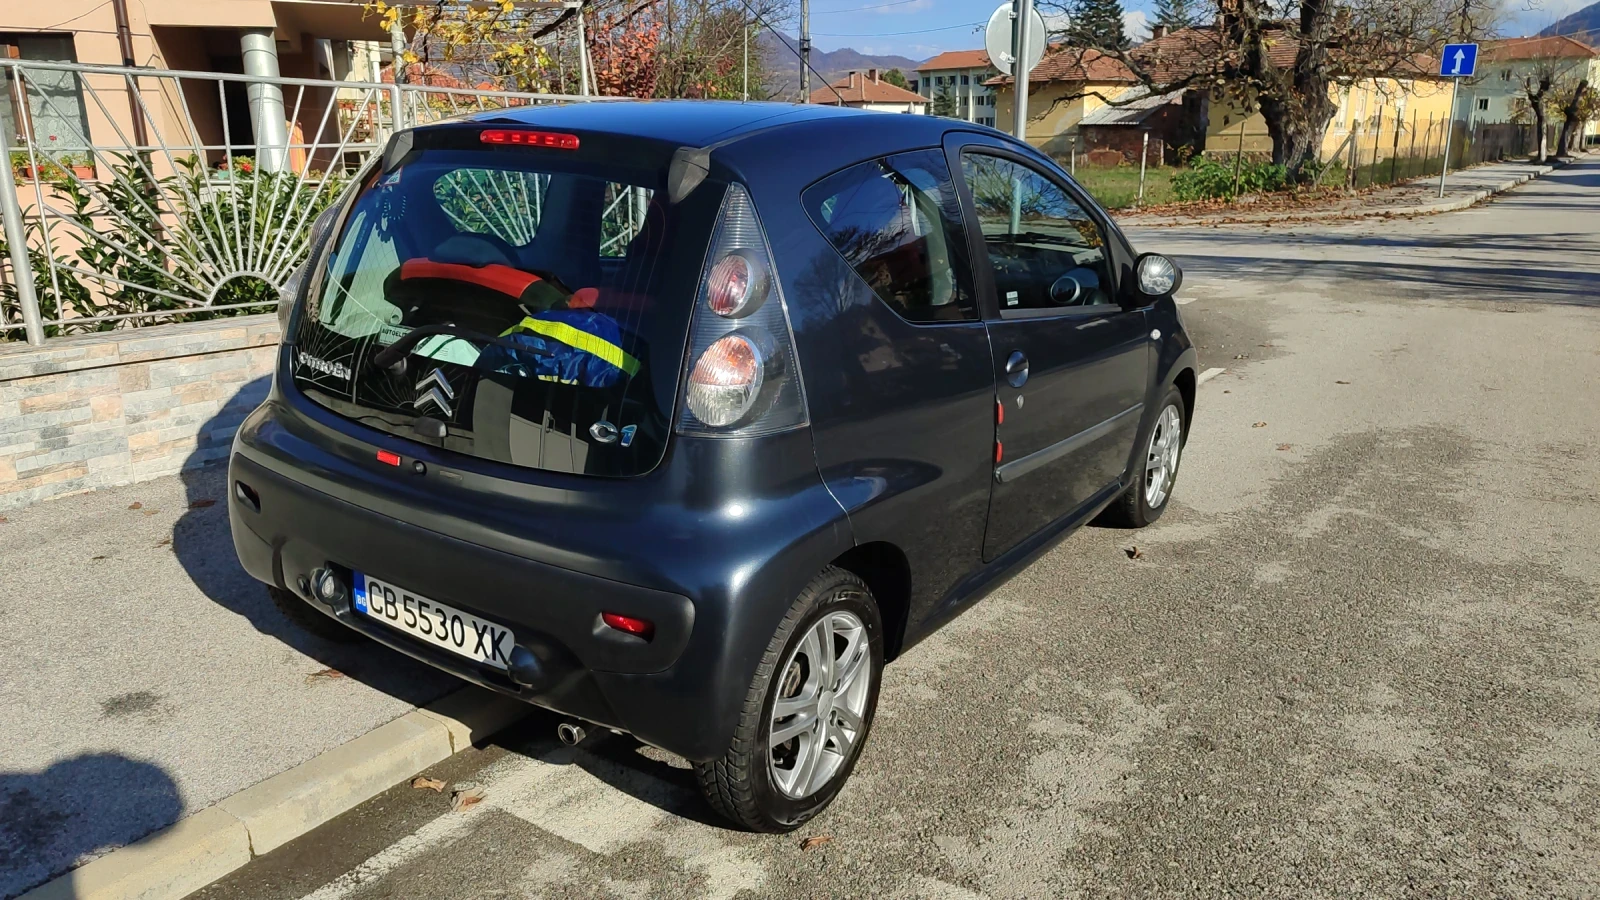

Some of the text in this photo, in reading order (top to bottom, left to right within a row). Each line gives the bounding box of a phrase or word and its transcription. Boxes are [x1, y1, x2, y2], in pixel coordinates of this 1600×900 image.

[589, 420, 638, 447] C1
[355, 594, 367, 607] BG
[471, 620, 510, 665] XK
